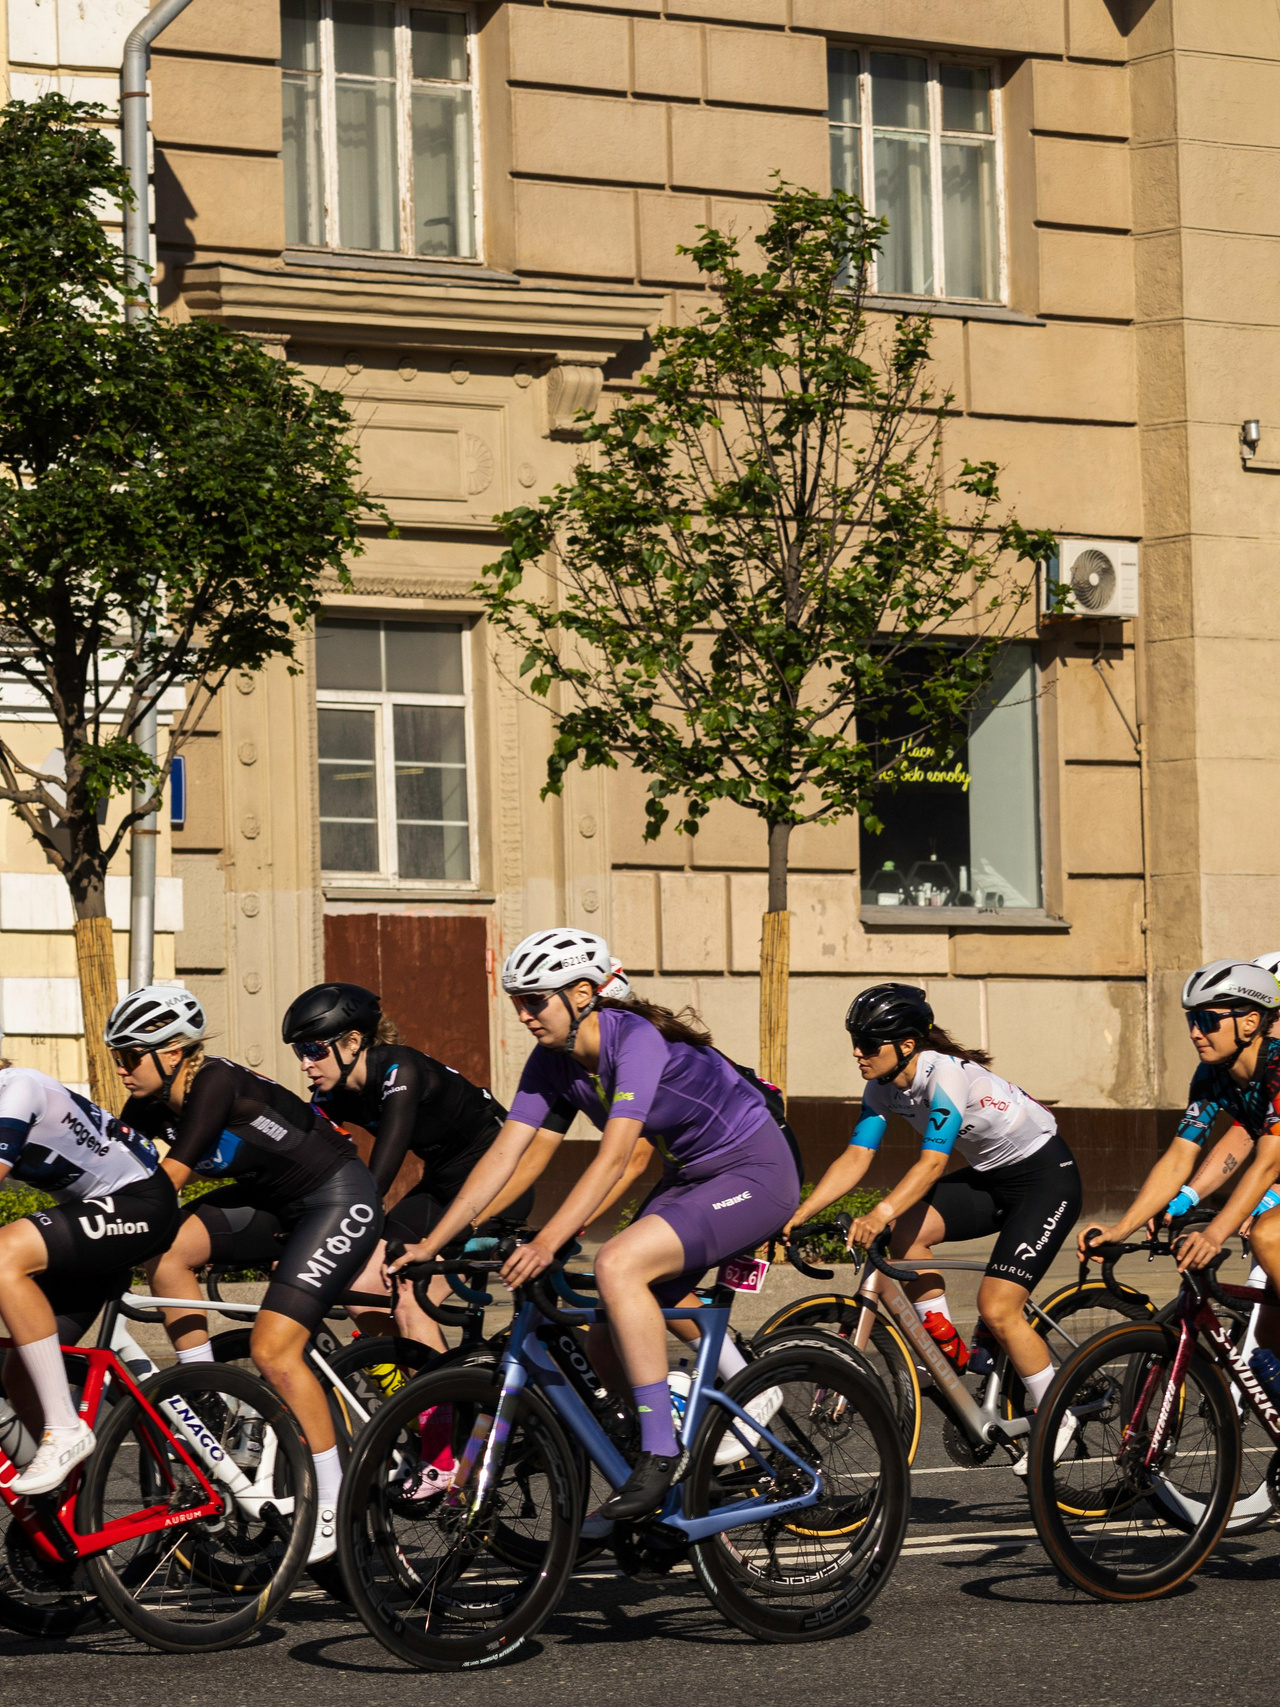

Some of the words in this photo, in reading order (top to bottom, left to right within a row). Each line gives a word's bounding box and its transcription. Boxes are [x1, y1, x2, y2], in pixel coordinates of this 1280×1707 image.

[561, 954, 587, 968] 6216
[165, 993, 193, 1008] KASK
[1225, 983, 1274, 1004] S-WORKS
[61, 1112, 110, 1157] Magene
[250, 1115, 289, 1142] МОСКВА
[711, 1190, 752, 1211] INBIKE
[78, 1214, 150, 1240] Union
[296, 1203, 375, 1289] МГФСО
[725, 1264, 758, 1286] 6216
[991, 1263, 1033, 1281] AURUM
[891, 1295, 960, 1390] POLYGON
[168, 1397, 225, 1462] LNAGO
[773, 1500, 804, 1513] JAVA
[164, 1509, 202, 1527] AURUM
